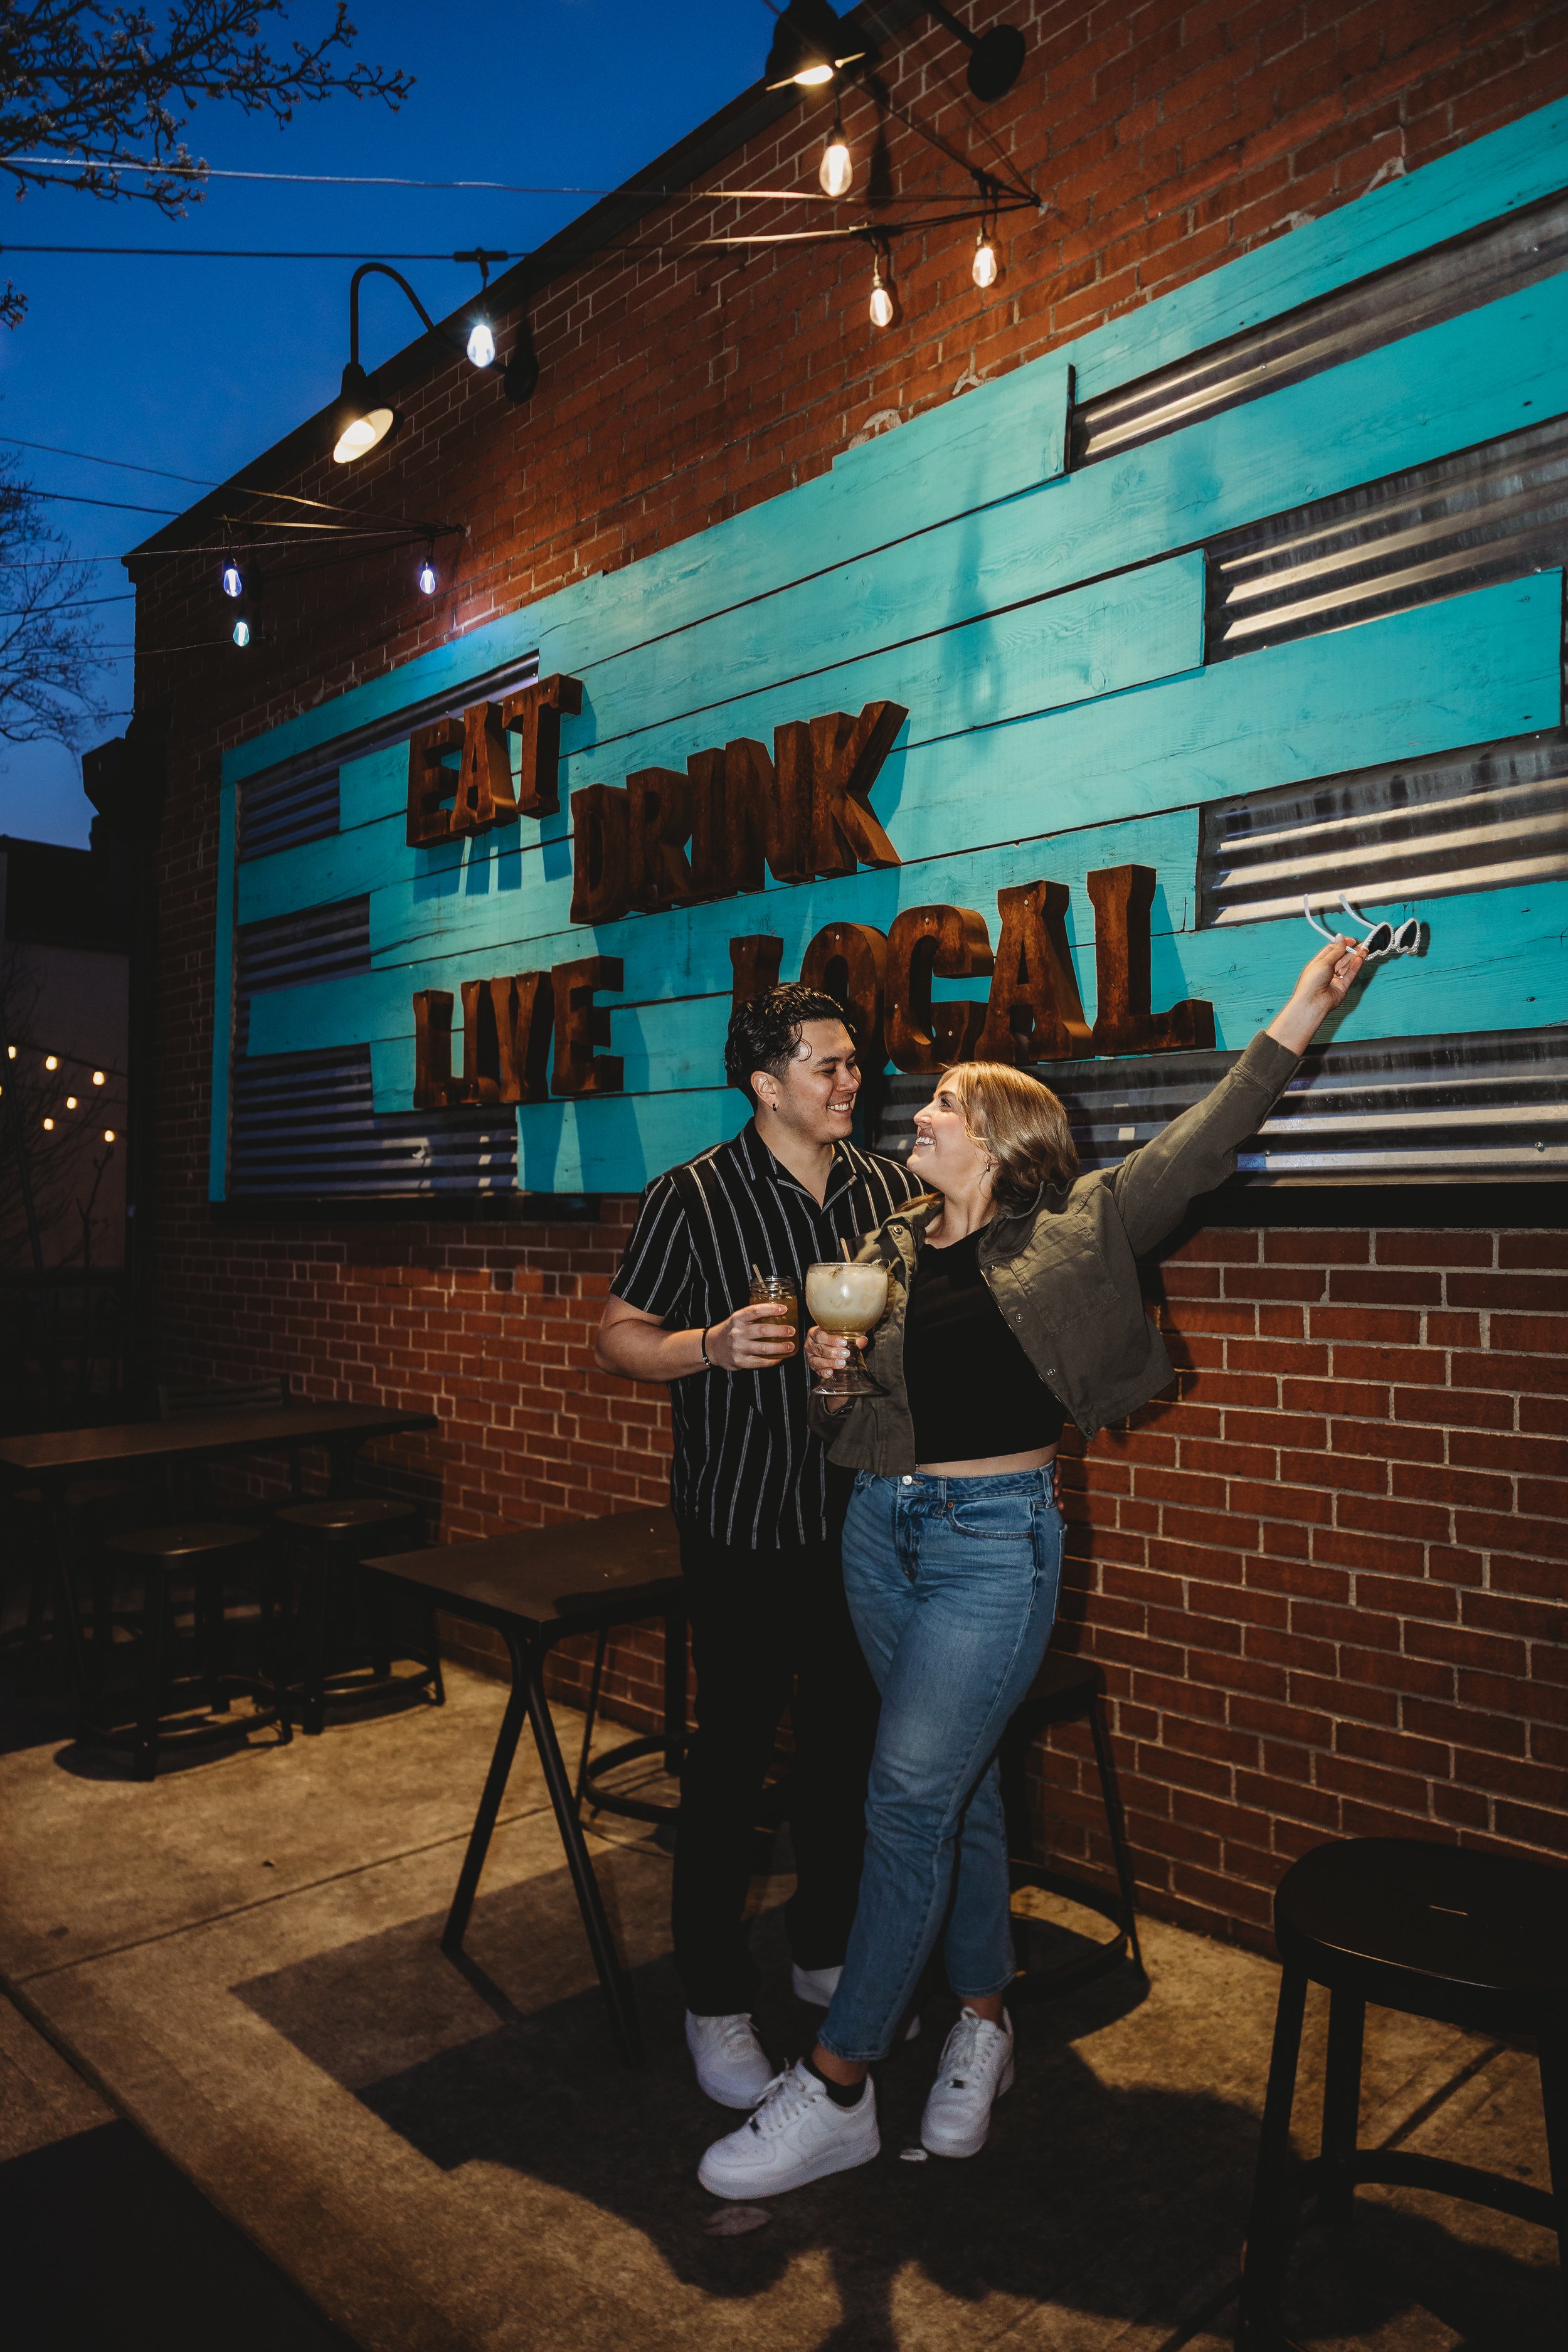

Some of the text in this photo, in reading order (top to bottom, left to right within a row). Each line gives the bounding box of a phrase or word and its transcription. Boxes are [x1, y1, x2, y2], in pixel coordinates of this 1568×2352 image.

[406, 673, 583, 849] EAT
[570, 700, 909, 924] DRINK
[413, 955, 624, 1108] LIVE
